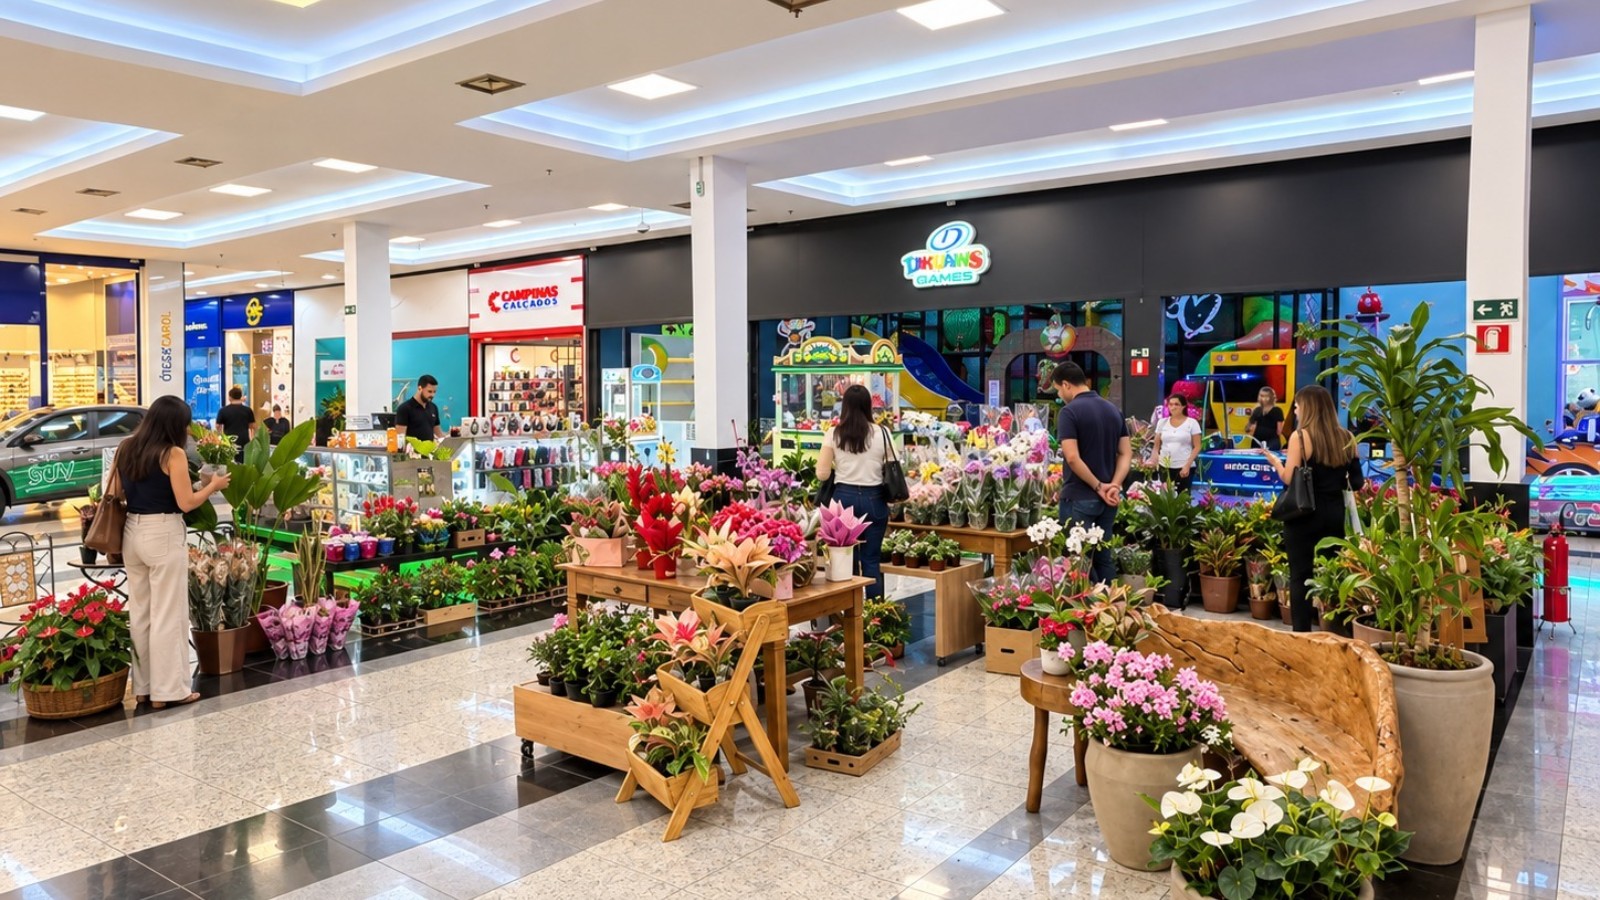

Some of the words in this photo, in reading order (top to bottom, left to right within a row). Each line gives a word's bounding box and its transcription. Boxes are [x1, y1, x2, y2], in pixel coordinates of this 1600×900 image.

[916, 271, 973, 284] GAMES
[501, 285, 559, 301] CAMPINAS
[160, 311, 172, 347] CAROL
